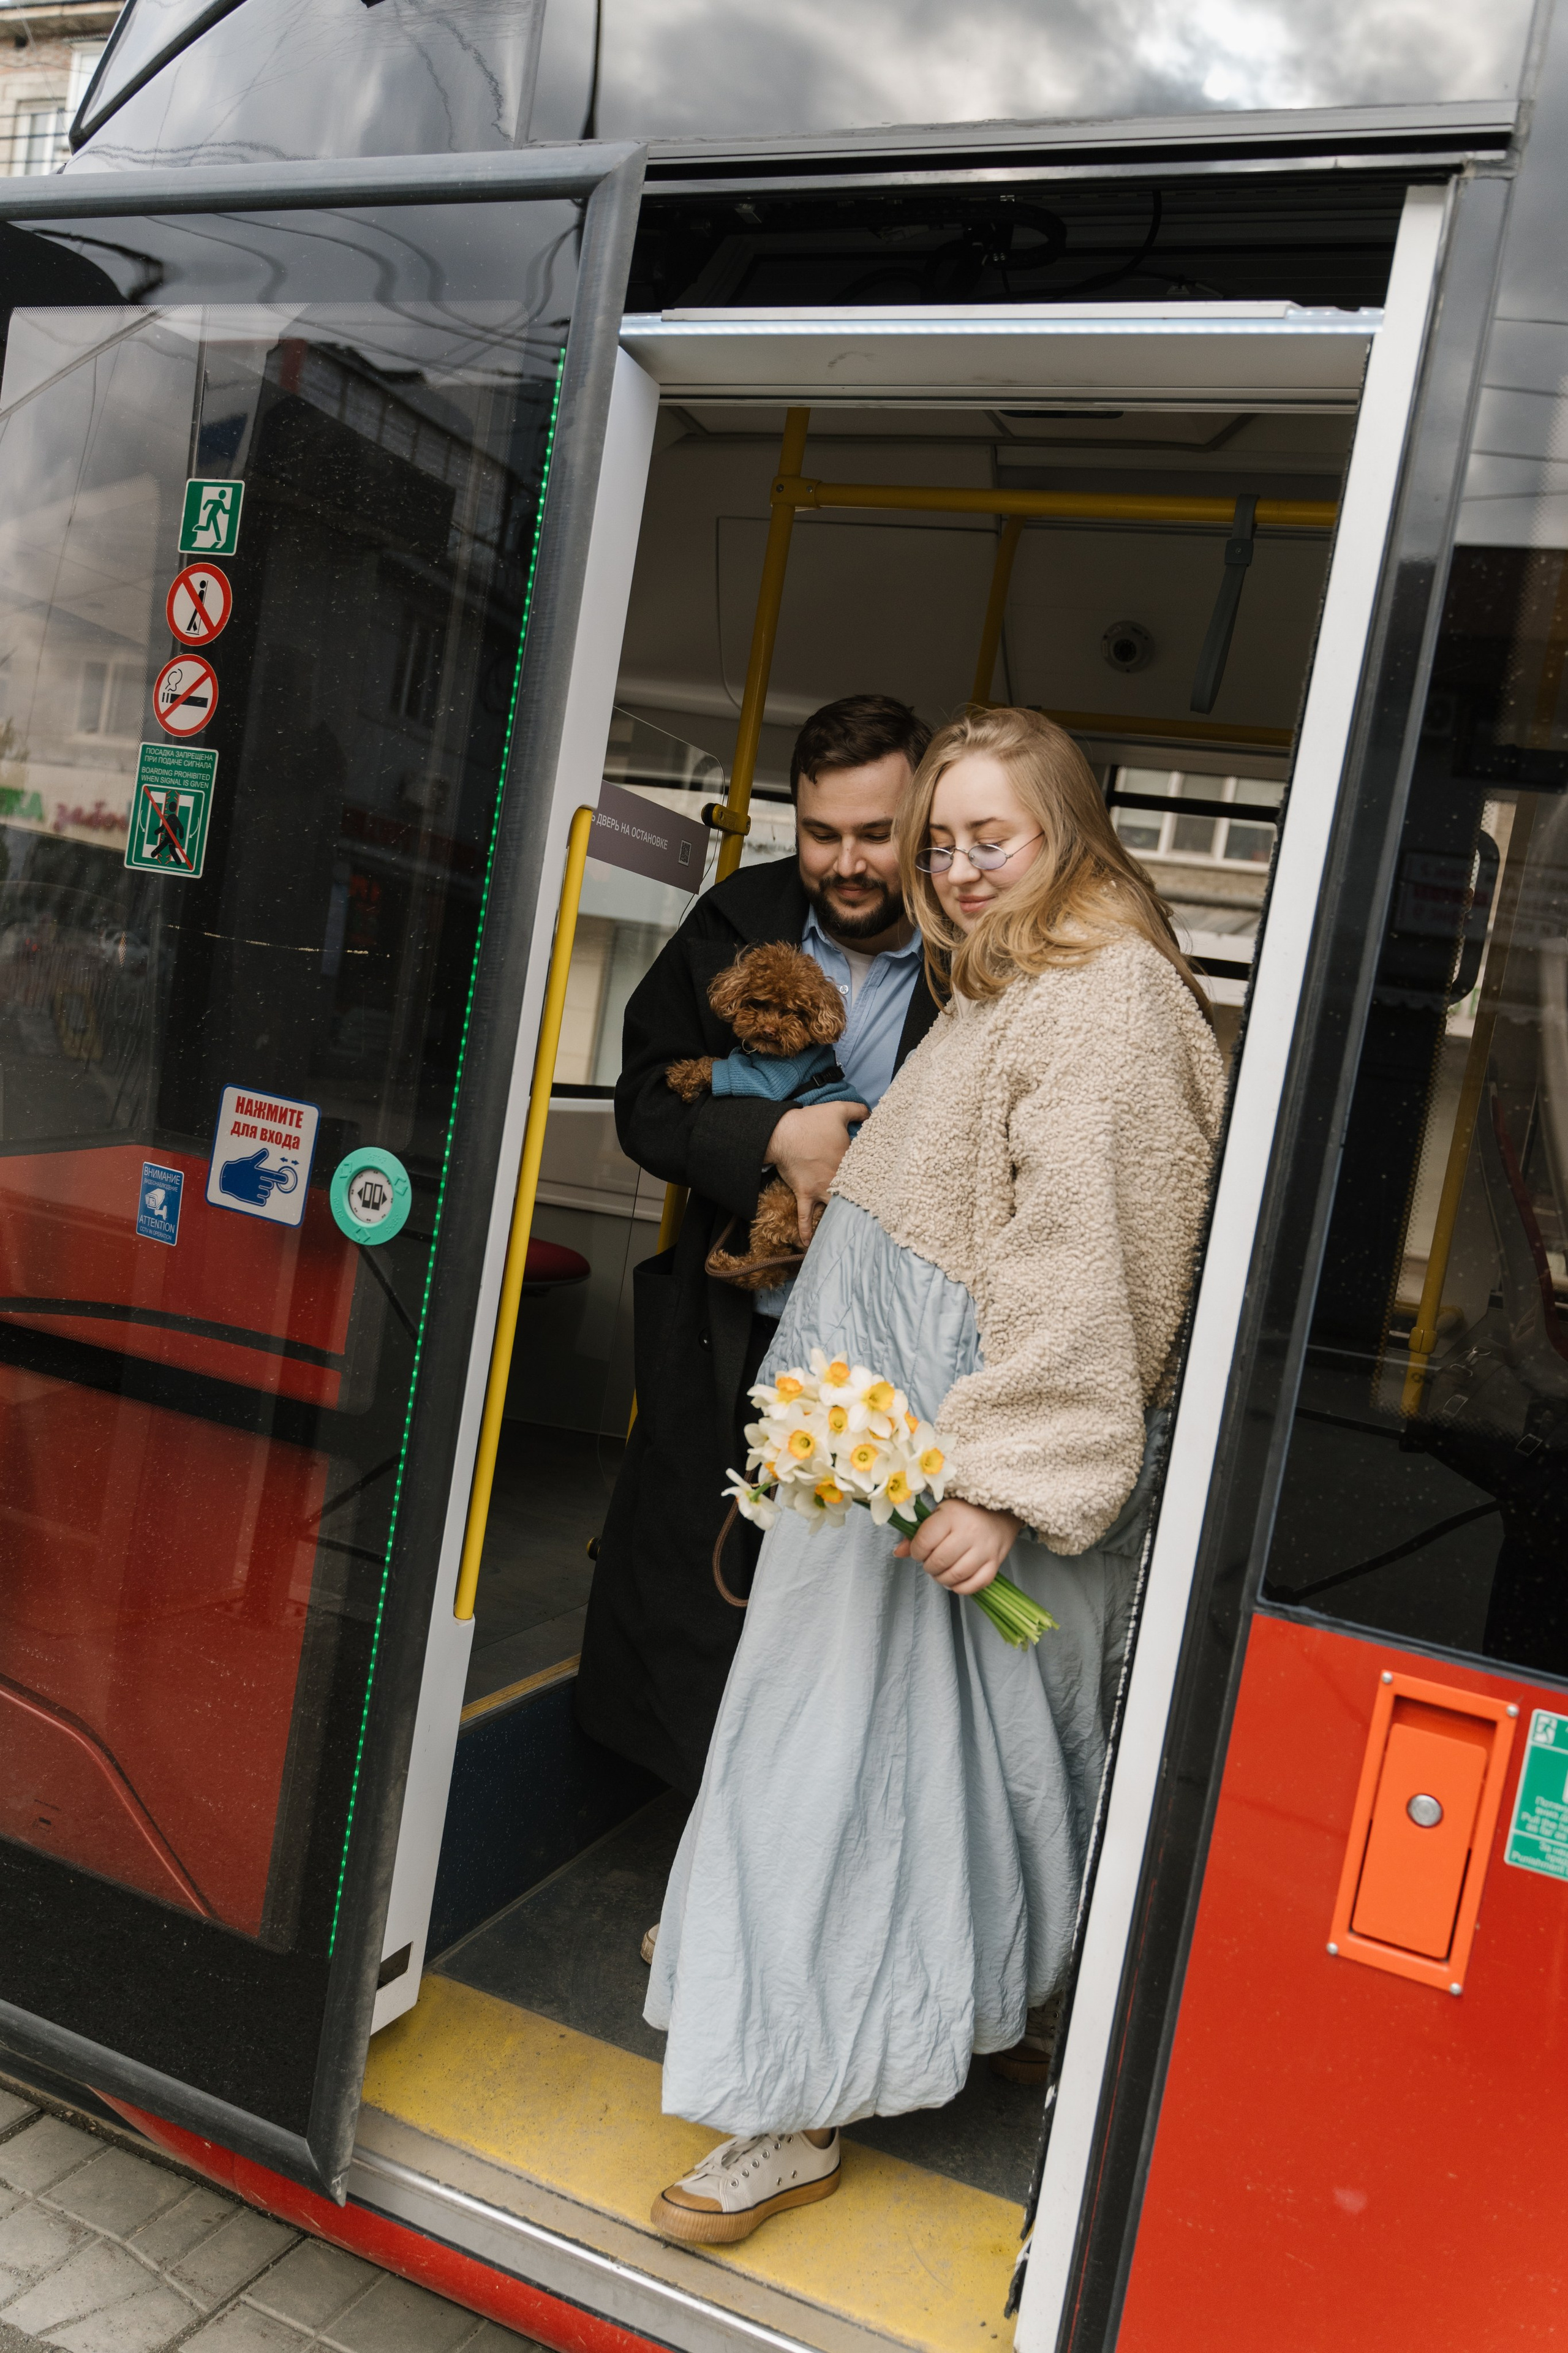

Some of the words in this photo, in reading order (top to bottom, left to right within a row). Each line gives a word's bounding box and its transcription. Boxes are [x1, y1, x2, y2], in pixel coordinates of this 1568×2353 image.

[146, 747, 174, 757] ПОСАДКА
[175, 751, 213, 761] ЗАПРЕЩЕНА
[158, 757, 183, 766] ПОДАЧЕ
[183, 760, 212, 769] СИГНАЛА
[141, 766, 173, 776] BOARDING
[174, 770, 211, 780] PROHIBITED
[141, 774, 159, 783] WHEN
[160, 776, 181, 786] SIGNAL
[596, 813, 620, 831] ДВЕРЬ
[620, 822, 630, 835] НА
[631, 827, 668, 850] ОСТАНОВКЕ
[235, 1095, 304, 1129] НАЖМИТЕ
[143, 1166, 181, 1185] ВНИМАНИЕ
[139, 1214, 175, 1234] ATTENTION
[153, 1230, 172, 1241] OPERATION
